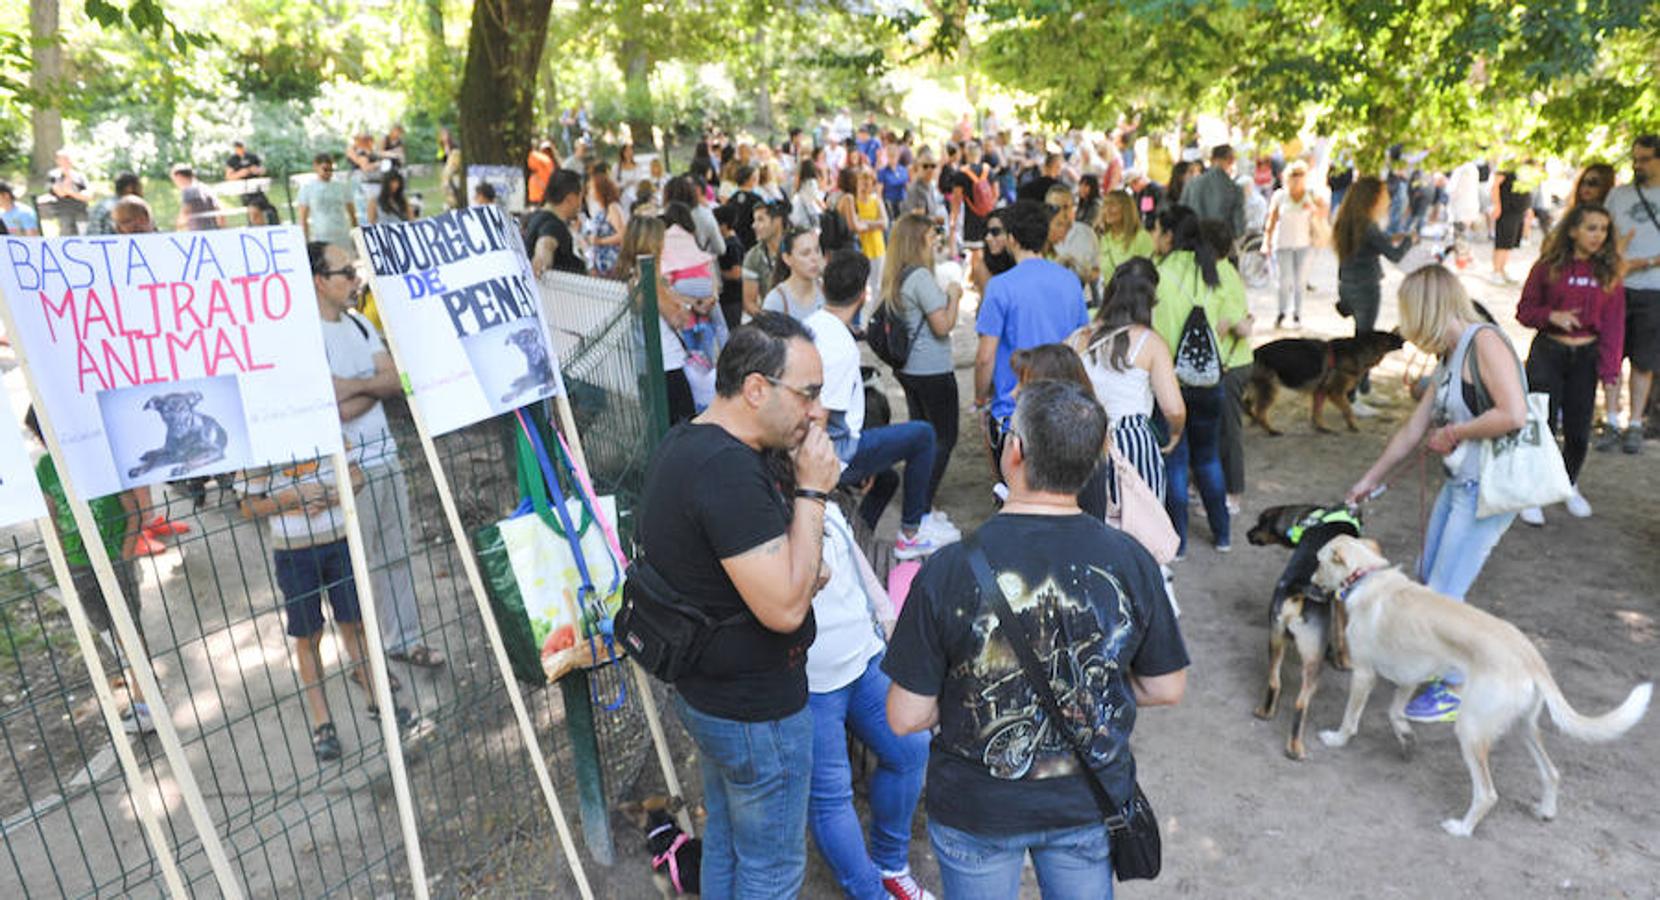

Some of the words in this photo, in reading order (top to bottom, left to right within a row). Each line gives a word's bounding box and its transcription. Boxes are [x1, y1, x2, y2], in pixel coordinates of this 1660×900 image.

[7, 237, 158, 290] BASTA
[170, 235, 226, 281] YA
[240, 230, 294, 277] DE
[404, 267, 447, 300] DE
[39, 272, 292, 342] MALTRATO
[78, 325, 275, 394] ANIMAL
